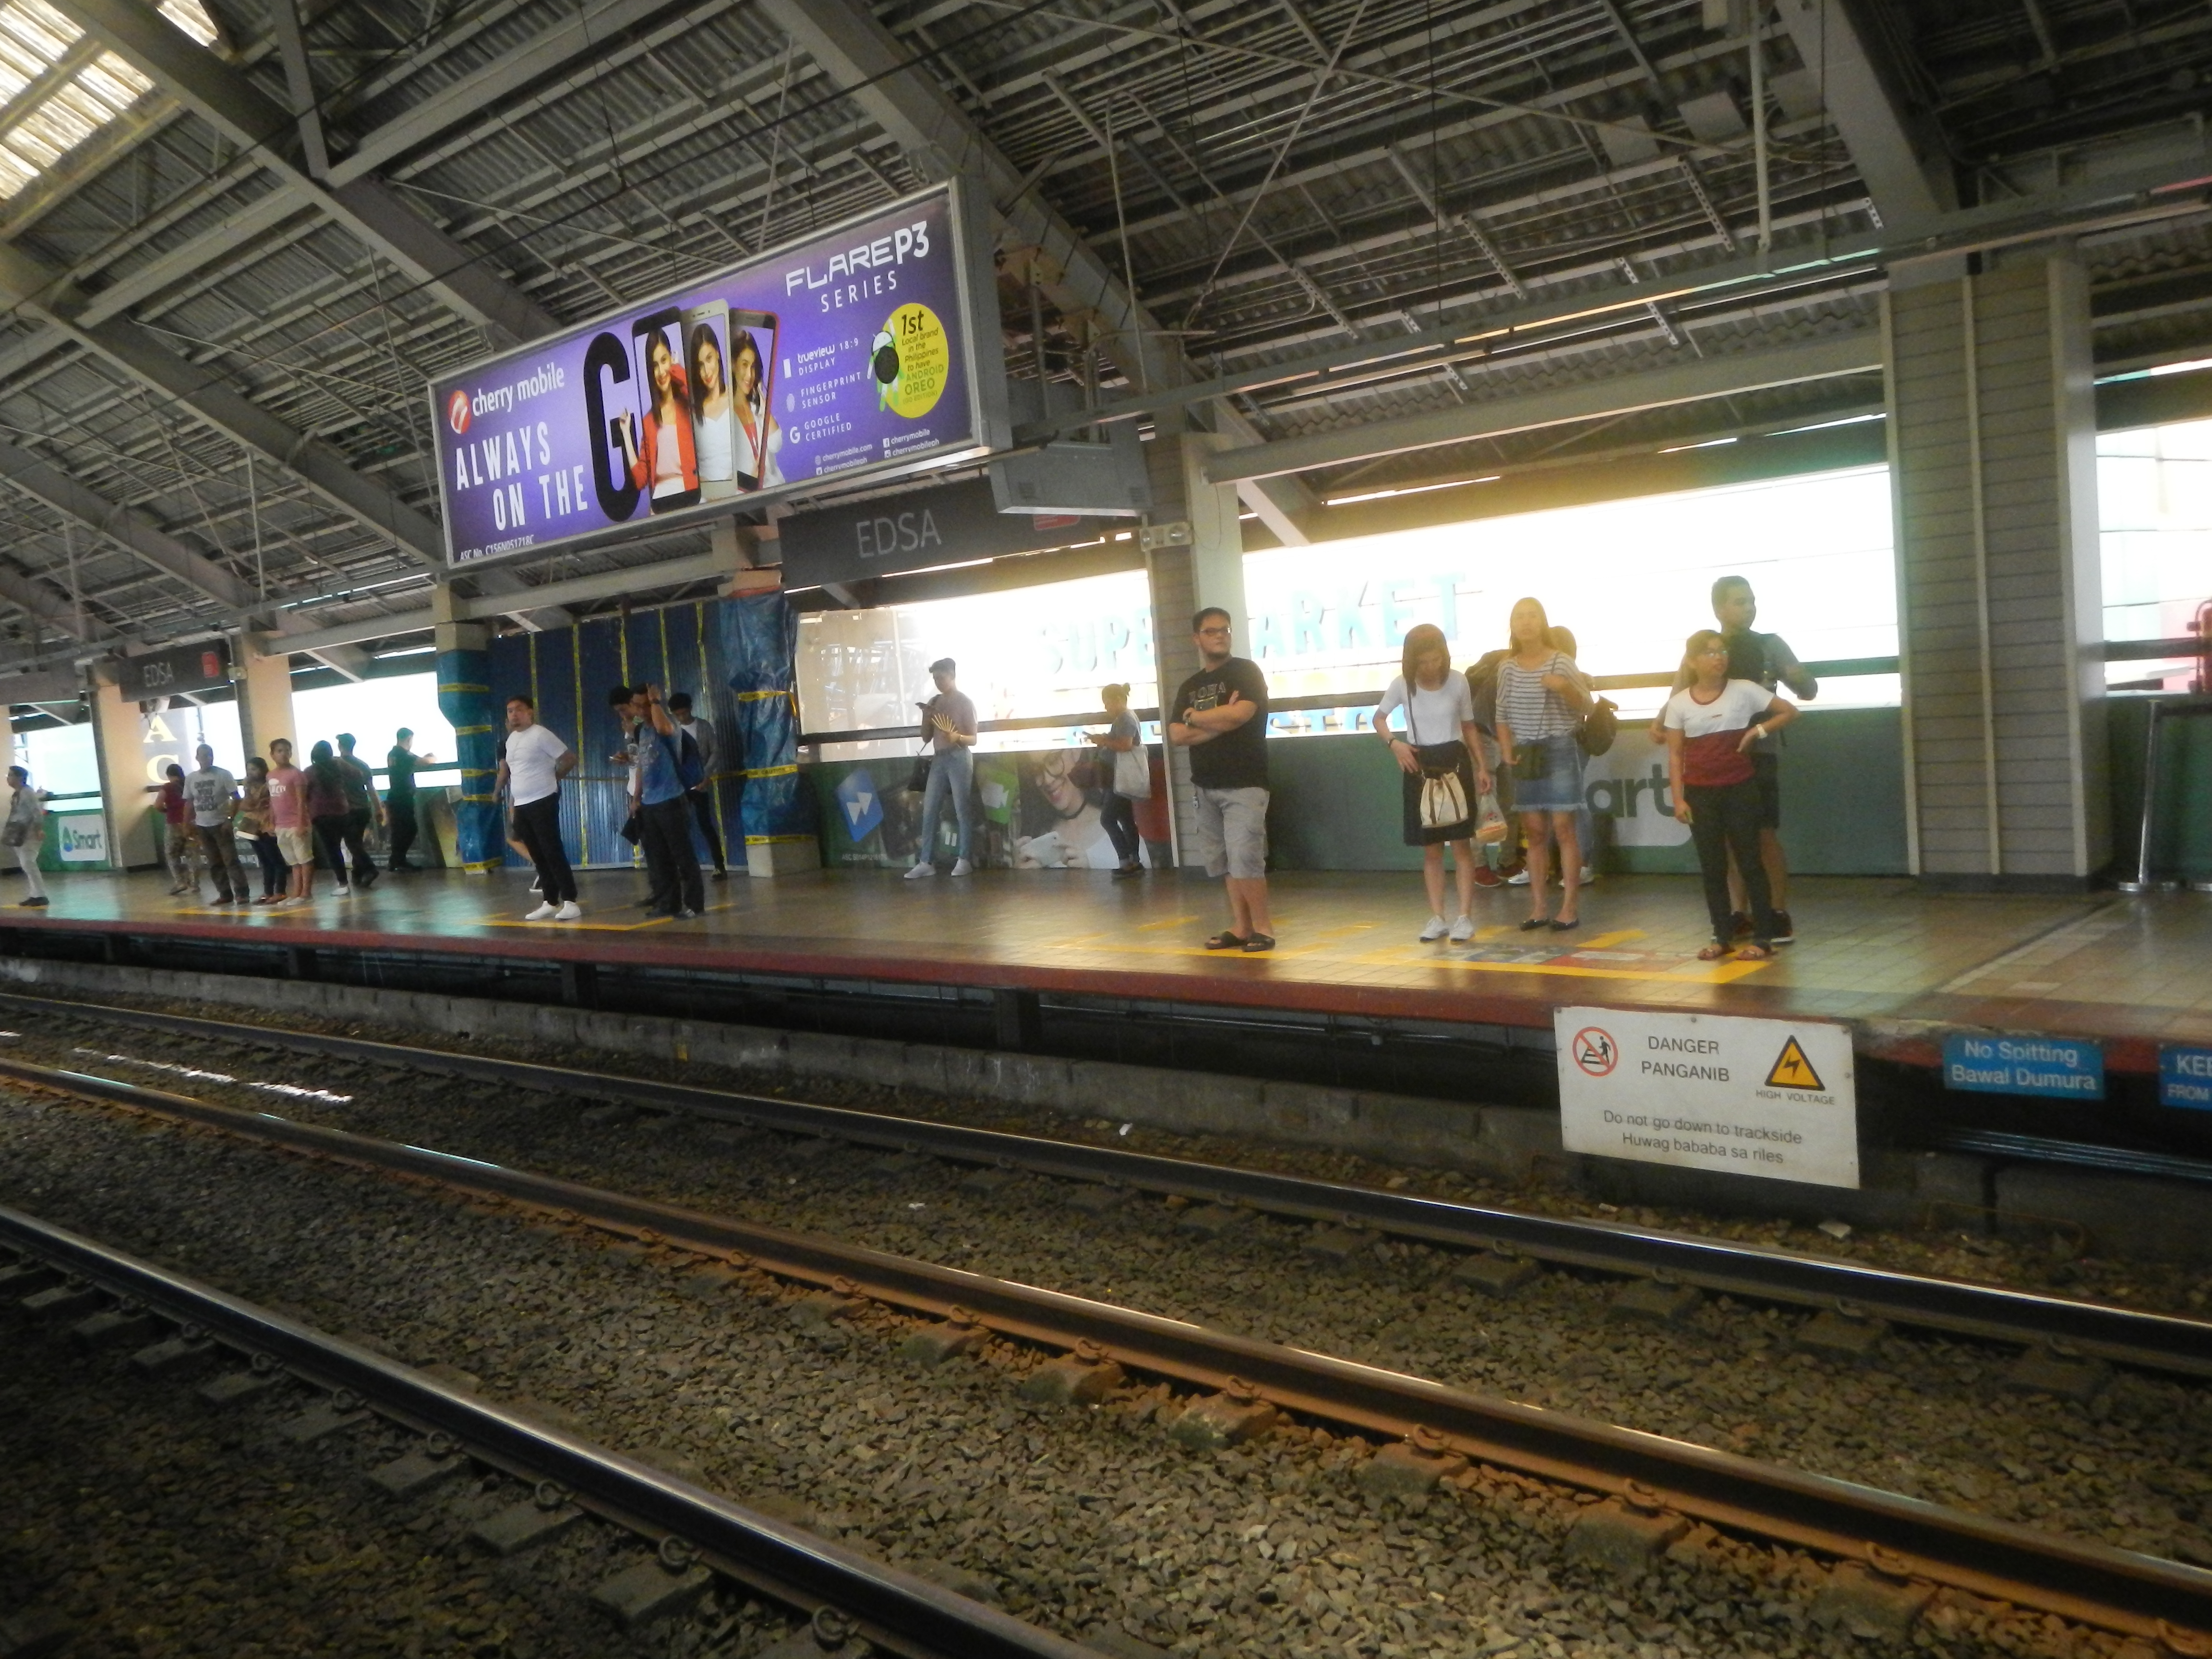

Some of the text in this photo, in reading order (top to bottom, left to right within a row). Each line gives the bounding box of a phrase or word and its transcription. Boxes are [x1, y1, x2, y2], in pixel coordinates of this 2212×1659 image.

[820, 270, 897, 313] SERIES
[902, 310, 924, 336] 1st
[902, 327, 938, 346] Local brand
[916, 342, 926, 350] the
[797, 337, 858, 363] trueview 18:9
[904, 348, 938, 362] Philippines
[798, 357, 835, 375] DISPLAY
[906, 364, 944, 382] ANDROID
[915, 360, 930, 369] have
[472, 361, 565, 416] cherry mobile
[801, 372, 861, 397] FINGERPRINT
[905, 377, 935, 395] OREO
[802, 391, 836, 409] SENSOR
[804, 412, 840, 430] GOOGLE
[805, 422, 852, 441] CERTIFIED
[891, 429, 930, 445] cherrymobile
[456, 421, 551, 491] ALWAYS
[822, 444, 873, 462] cherrymobile.com
[892, 438, 940, 456] cherrymobileph
[824, 457, 867, 473] cherrymobileph
[493, 465, 588, 531] ON THE
[856, 509, 942, 559] EDSA
[144, 662, 175, 687] EDSA
[1585, 761, 1674, 817] art
[73, 829, 103, 850] Smart
[1647, 1036, 1719, 1055] DANGER
[1965, 1040, 2078, 1068] No Spitting
[1641, 1060, 1730, 1082] PANGANIB
[1951, 1064, 2096, 1090] Bawal Dumura
[1755, 1089, 1835, 1105] HIGH VOLTAGE
[2167, 1083, 2209, 1101] FROM
[1604, 1110, 1802, 1144] Do not go down to trackside
[1623, 1132, 1784, 1164] Huwag bababa sa riles
